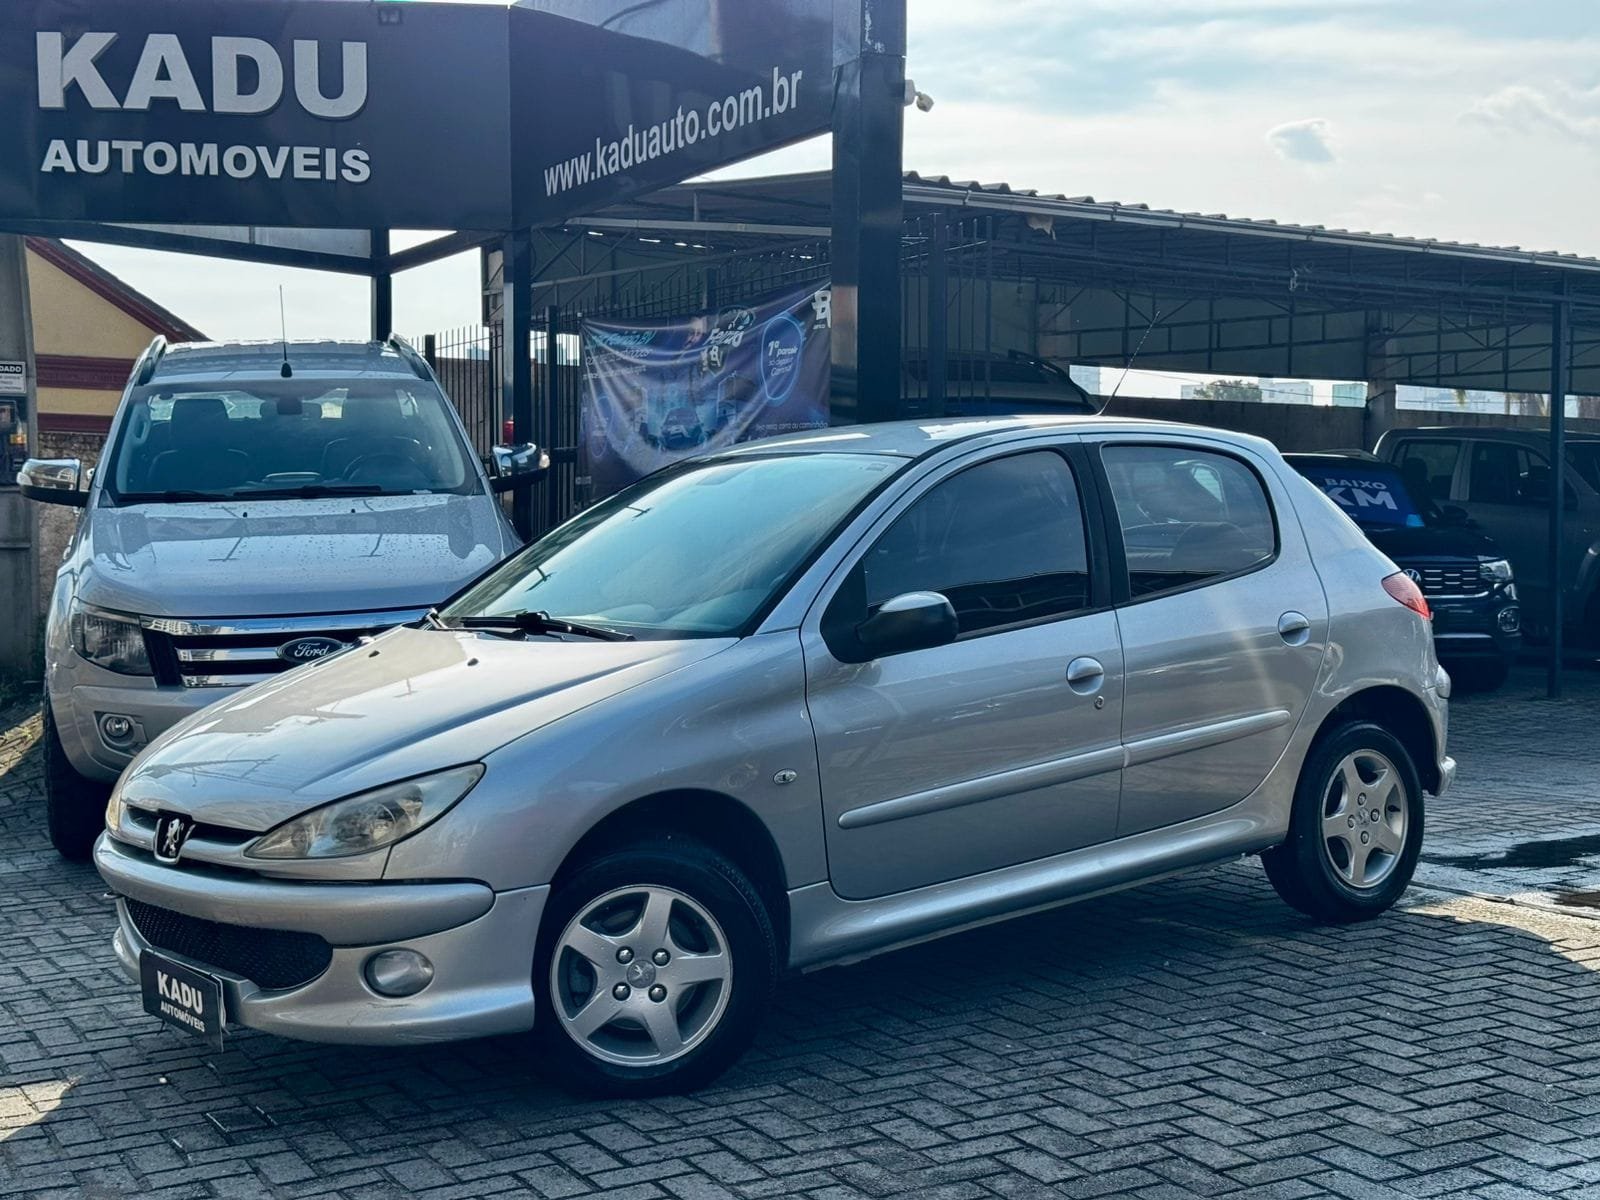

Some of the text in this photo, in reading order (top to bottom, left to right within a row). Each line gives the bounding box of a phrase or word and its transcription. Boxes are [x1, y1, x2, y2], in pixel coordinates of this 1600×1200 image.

[36, 31, 368, 119] KADU
[544, 66, 803, 197] www.kaduauto.com.br
[41, 139, 371, 183] AUTOMOVEIS
[1324, 478, 1388, 490] BAIXO
[294, 642, 330, 658] Ford
[157, 970, 203, 1014] KADU
